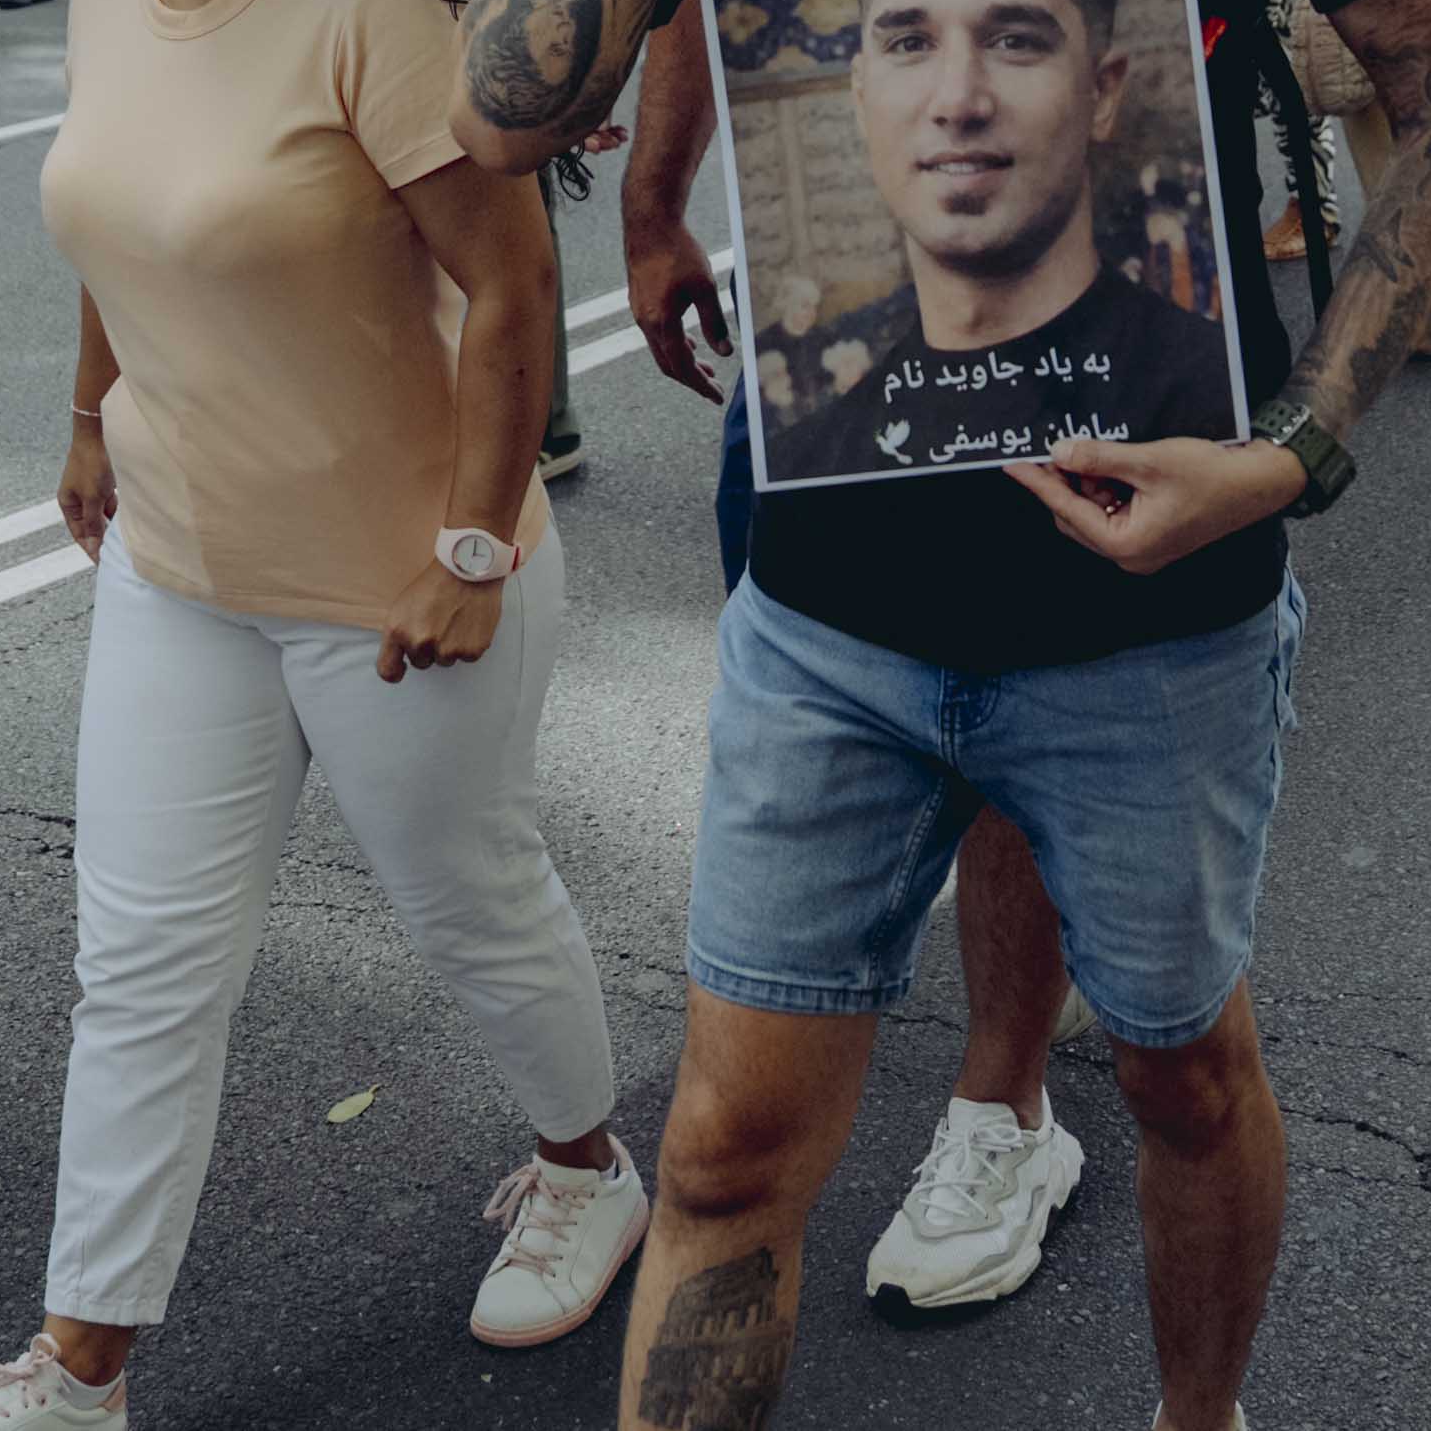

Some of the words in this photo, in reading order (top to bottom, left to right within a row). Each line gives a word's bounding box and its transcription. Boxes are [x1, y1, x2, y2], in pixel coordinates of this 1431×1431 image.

[884, 359, 925, 404] نام
[935, 350, 1025, 392] جاوید
[1034, 346, 1073, 383] یاد
[1082, 352, 1111, 382] به
[929, 424, 1033, 463] یوسفی
